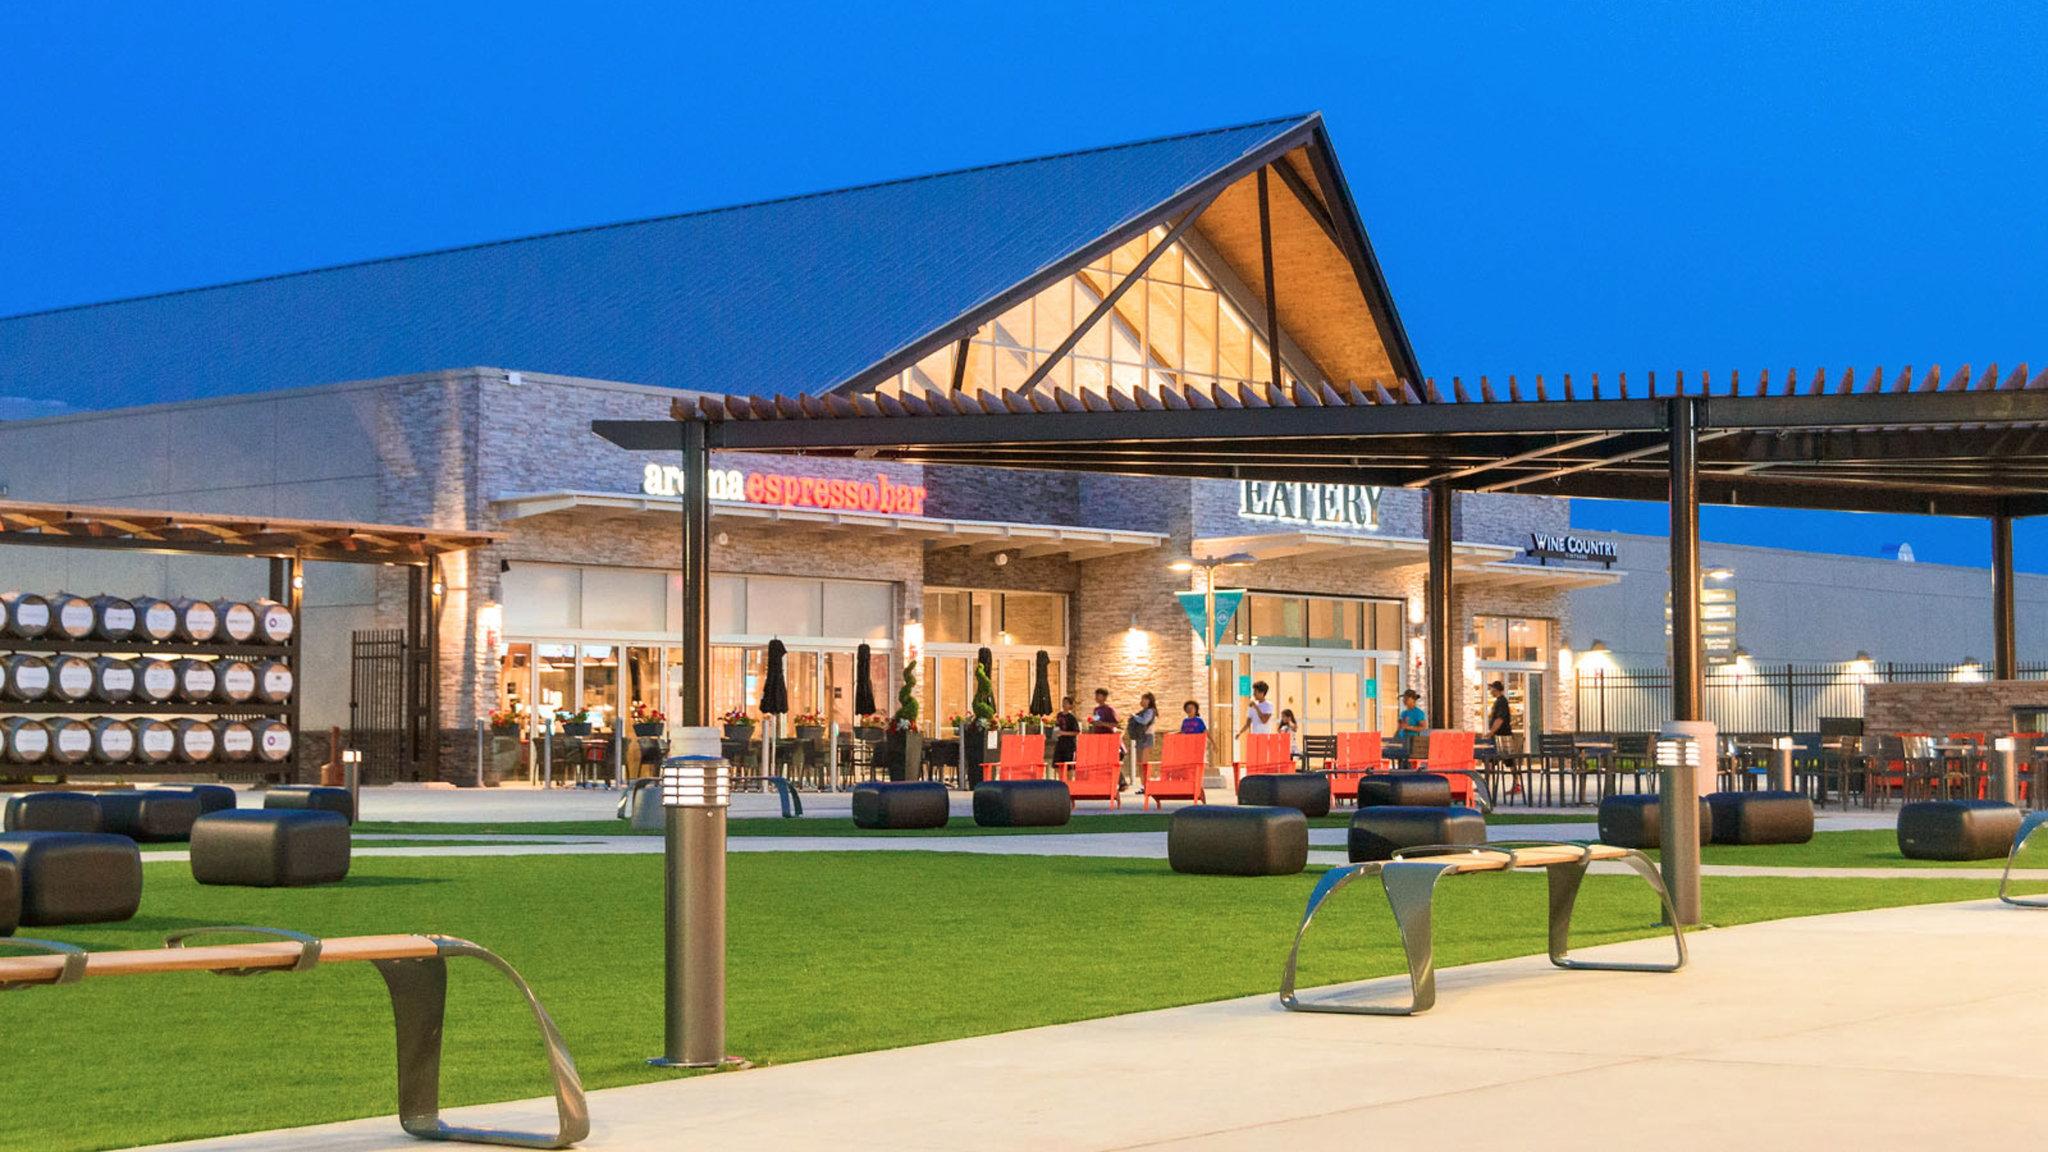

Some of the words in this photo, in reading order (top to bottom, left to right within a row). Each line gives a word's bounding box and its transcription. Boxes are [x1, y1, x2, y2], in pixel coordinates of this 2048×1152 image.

[644, 464, 745, 500] arma
[1239, 480, 1384, 528] EATERY
[1535, 533, 1565, 552] WINE
[1567, 535, 1617, 556] COUNTRY
